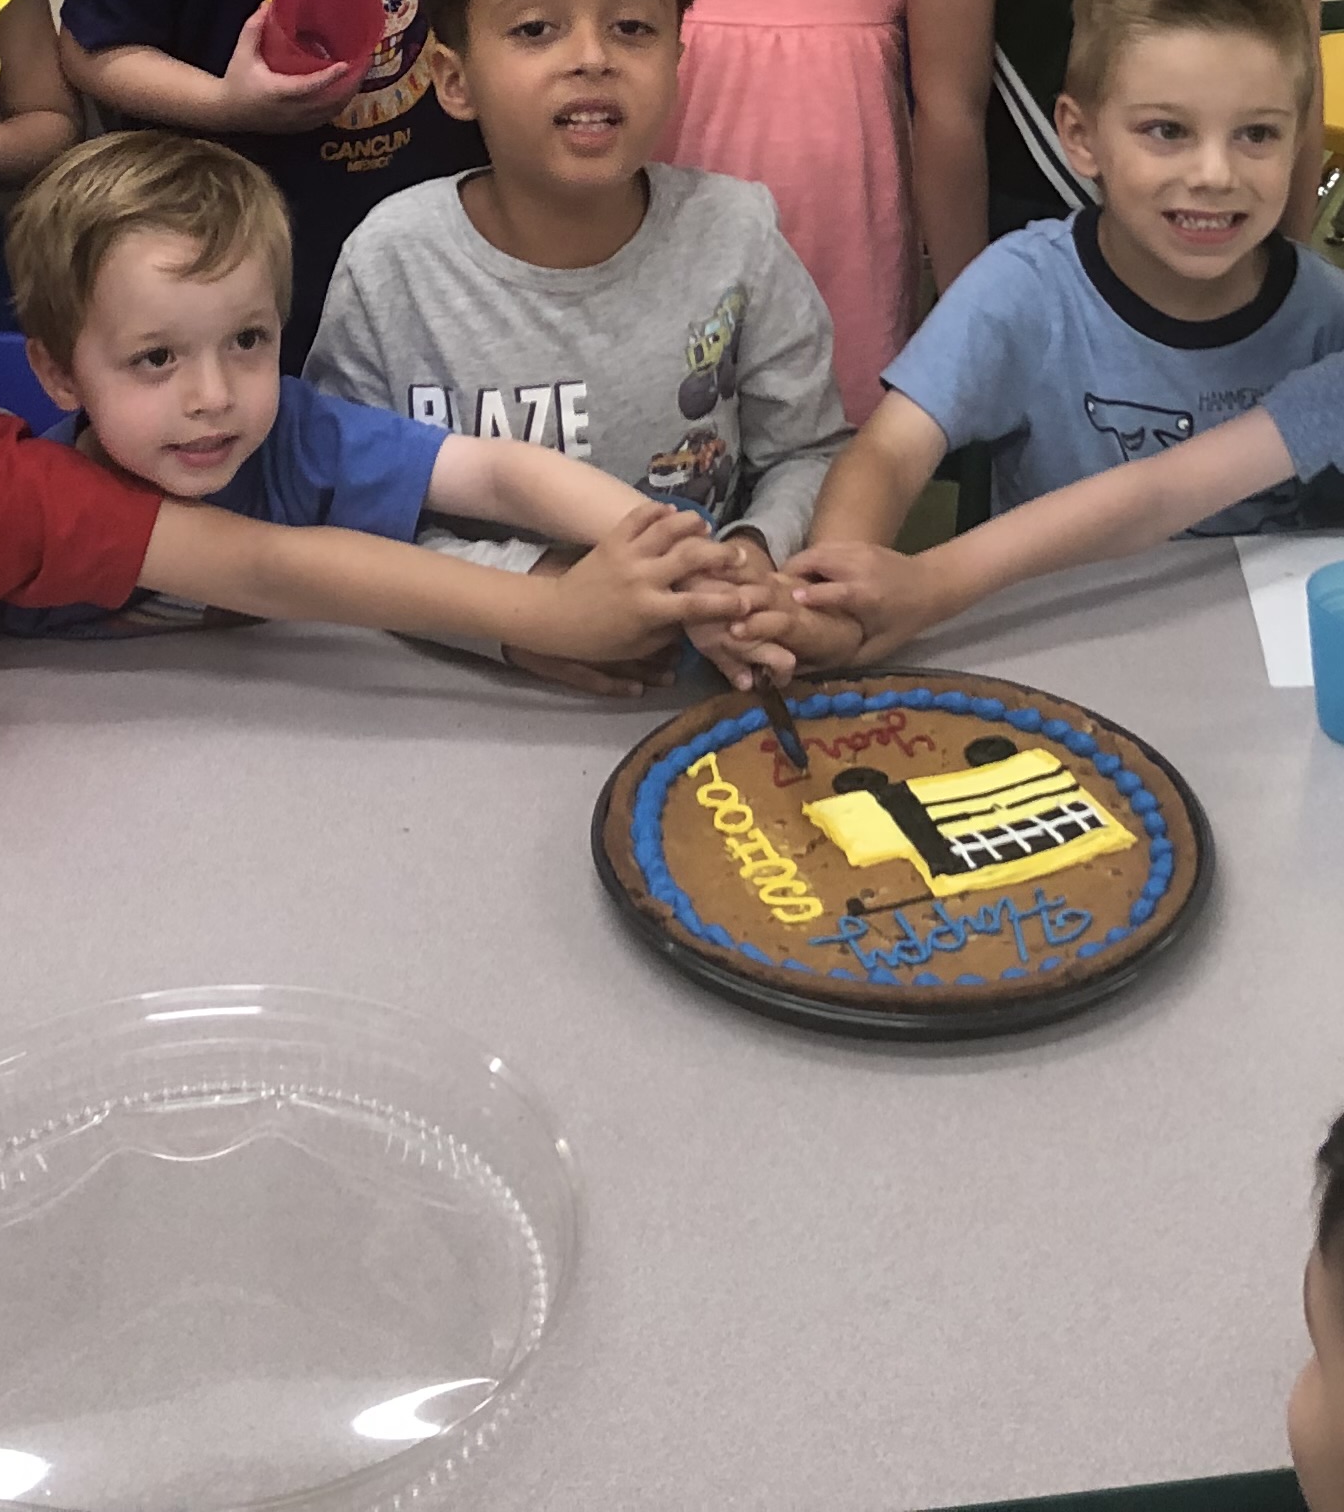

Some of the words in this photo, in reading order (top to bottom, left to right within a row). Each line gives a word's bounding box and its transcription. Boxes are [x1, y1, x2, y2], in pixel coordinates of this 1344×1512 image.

[321, 127, 411, 160] CANCUN
[686, 751, 824, 924] SCHOOL
[808, 888, 1093, 971] Happy
